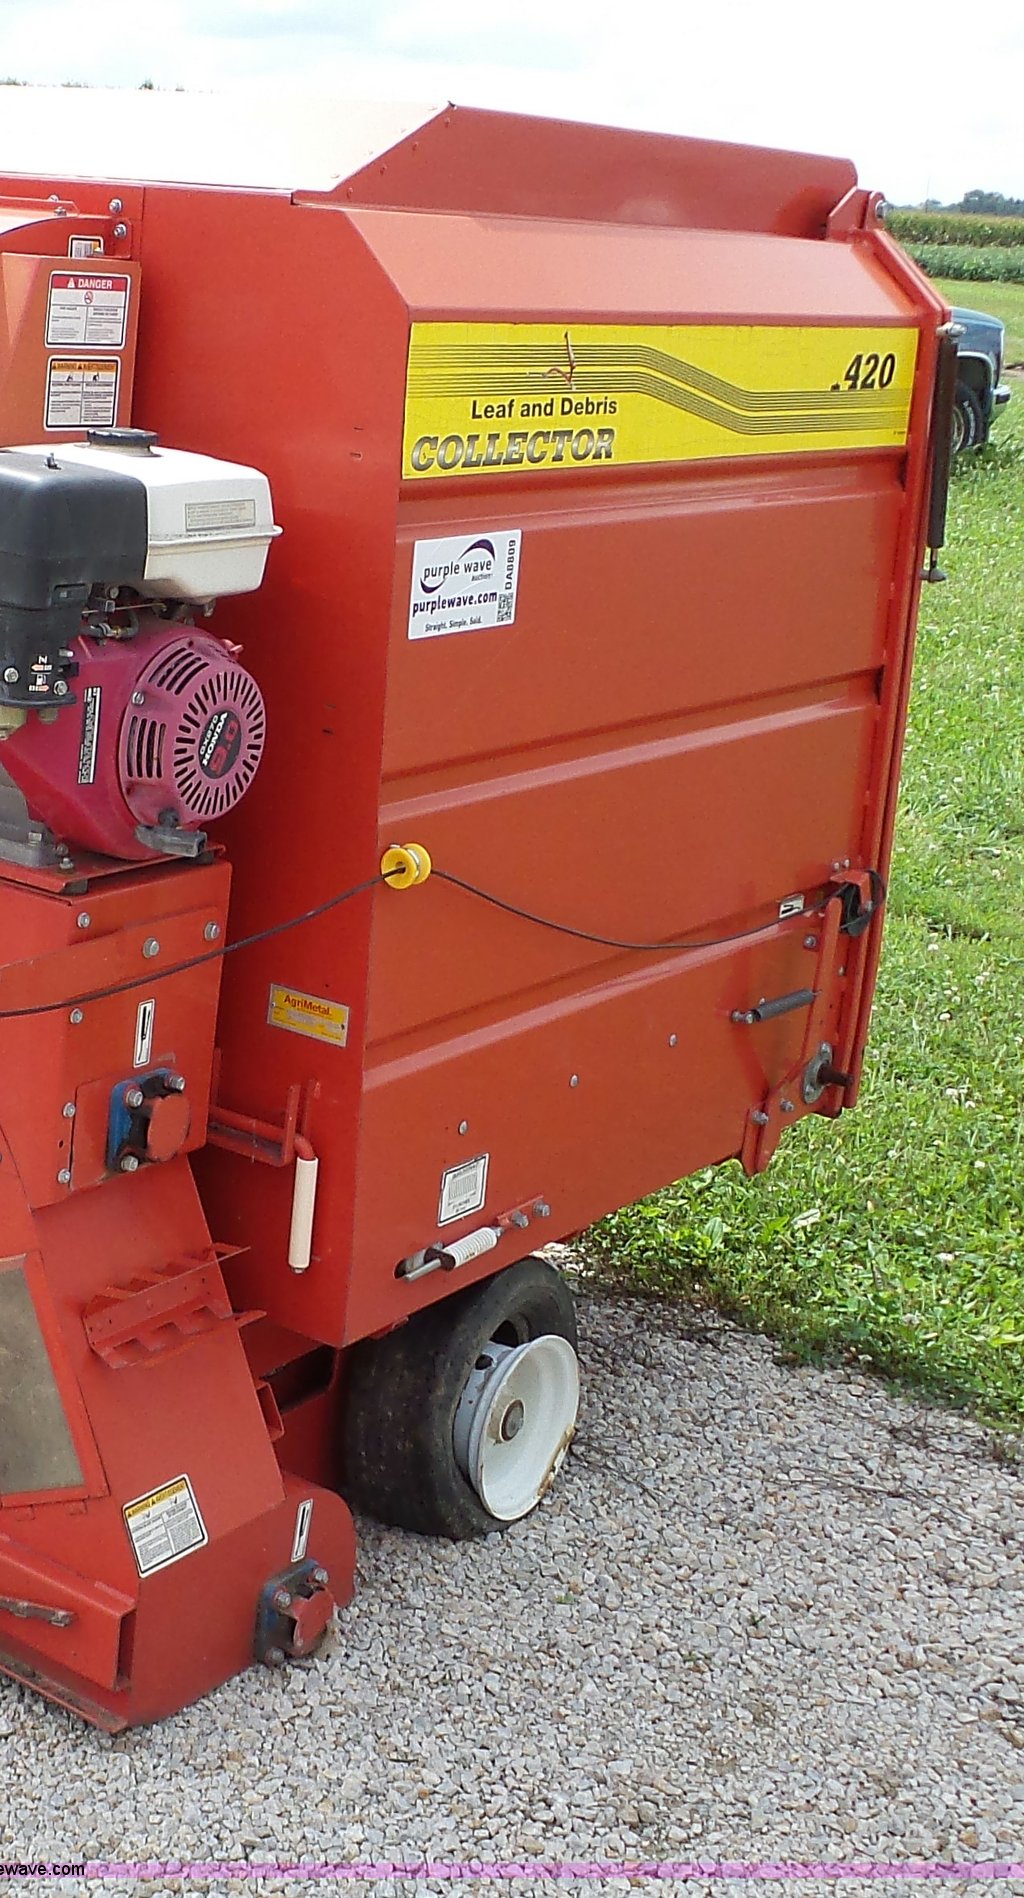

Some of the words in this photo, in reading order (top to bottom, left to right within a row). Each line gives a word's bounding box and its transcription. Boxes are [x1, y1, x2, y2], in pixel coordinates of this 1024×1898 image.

[77, 278, 113, 290] DANGER
[471, 399, 515, 420] Leaf
[520, 398, 554, 418] and
[560, 396, 617, 415] Debris
[411, 429, 615, 471] COLLECTOR
[423, 561, 460, 582] purple
[464, 560, 492, 574] wave
[412, 592, 498, 618] purplewave.com
[202, 712, 228, 767] HONDA
[284, 995, 330, 1015] AgriMetal
